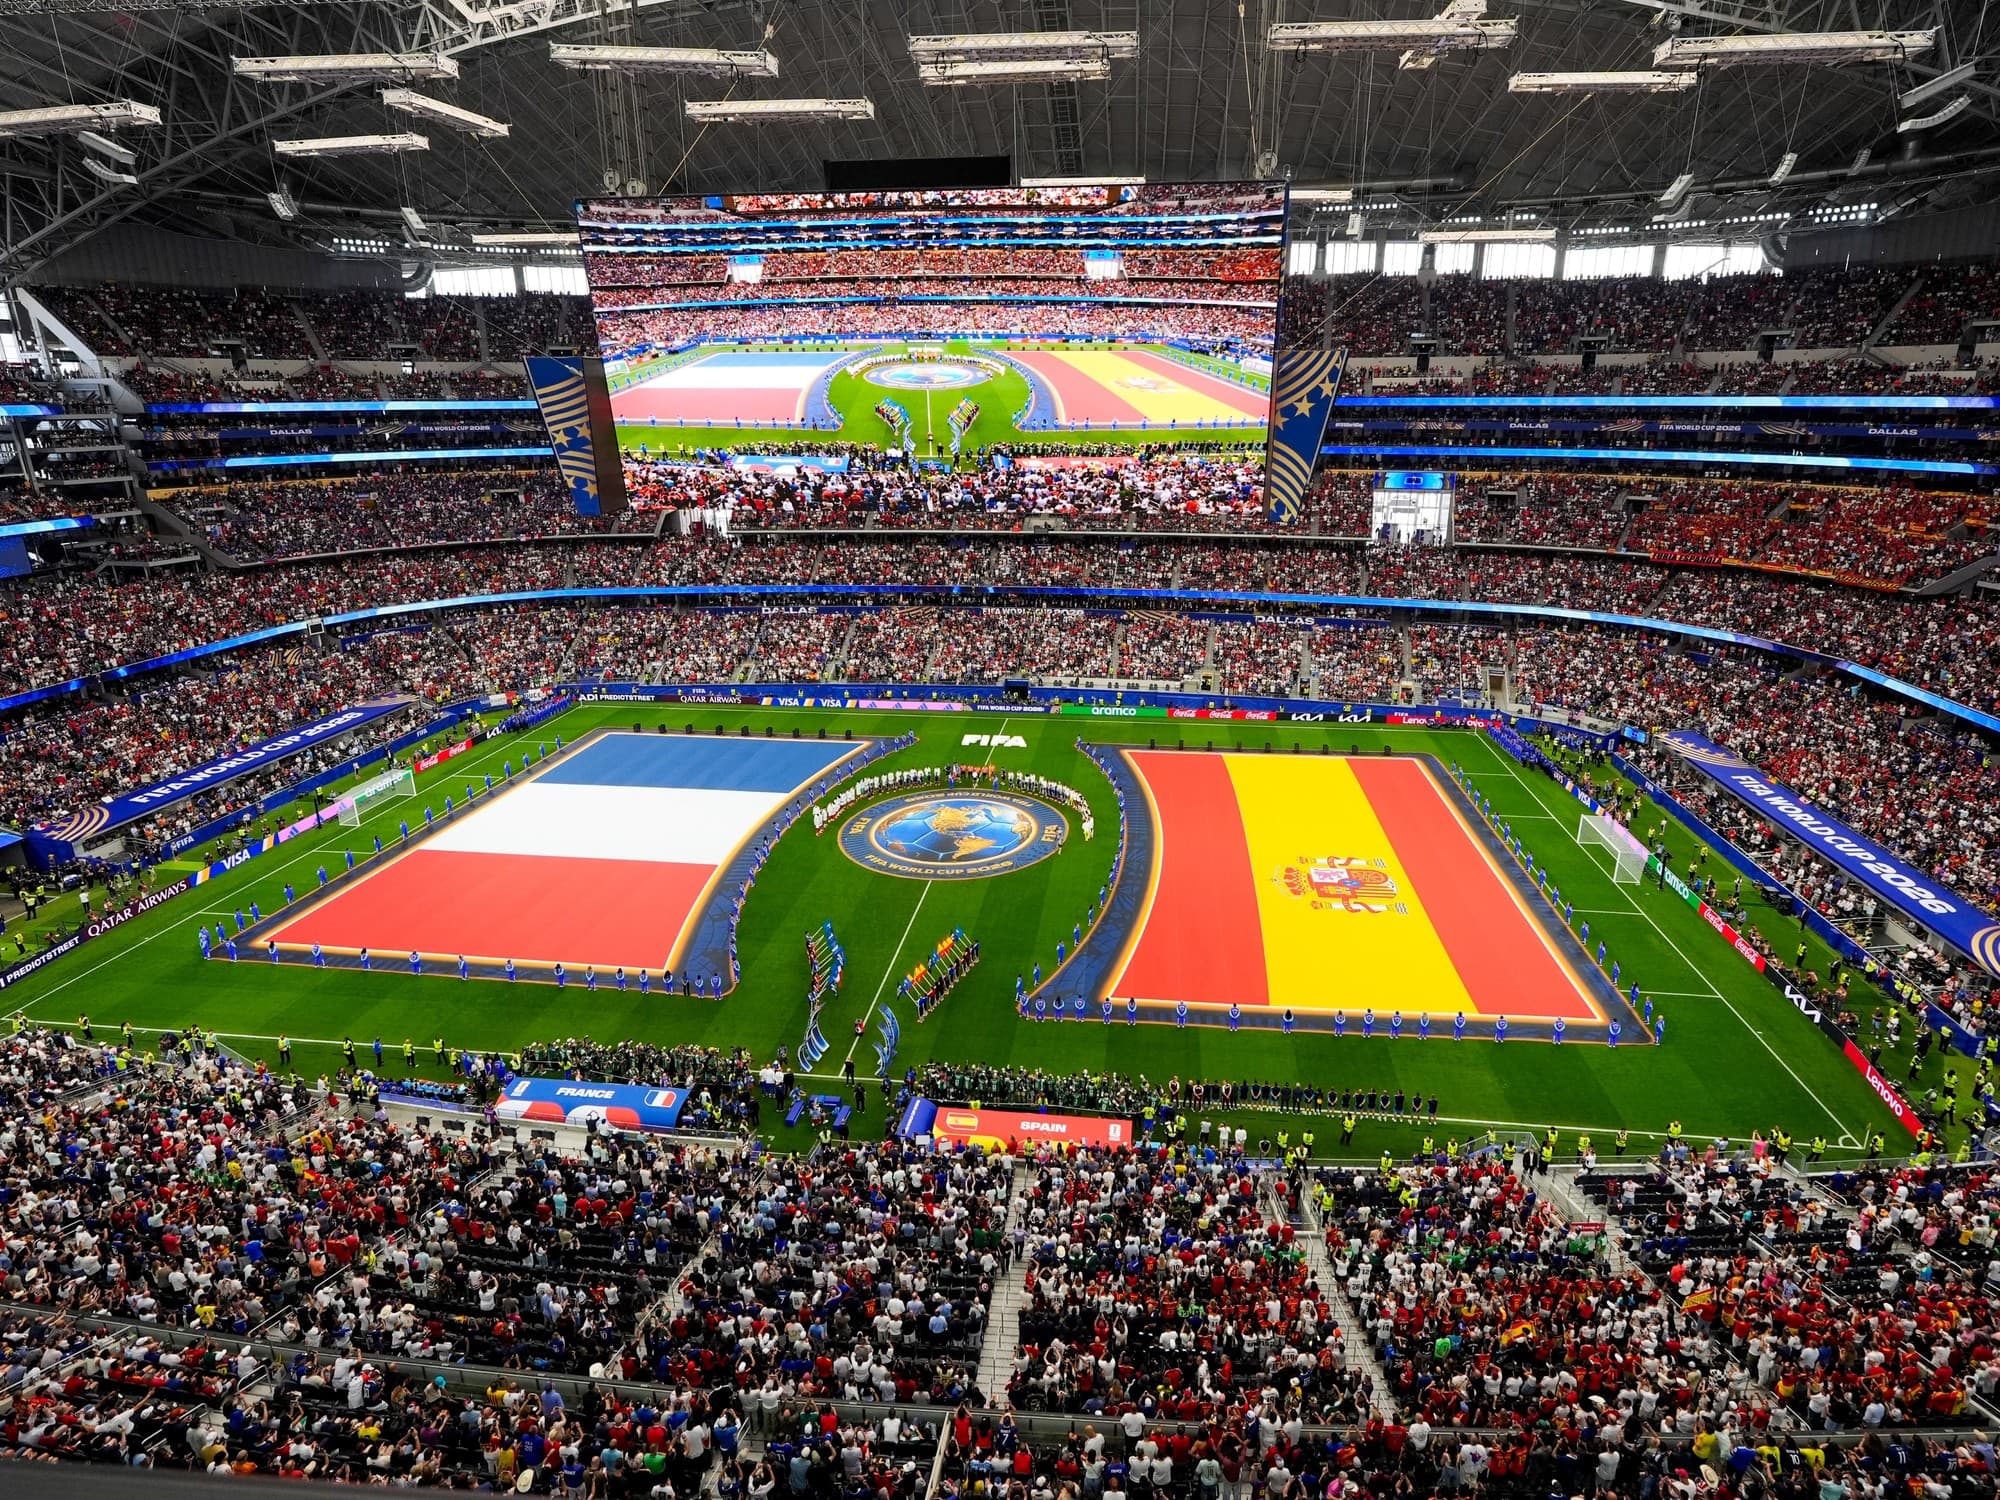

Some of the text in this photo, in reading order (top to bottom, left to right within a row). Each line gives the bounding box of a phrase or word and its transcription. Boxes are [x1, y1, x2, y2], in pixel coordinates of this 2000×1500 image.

[1868, 428, 1918, 436] DALLAS
[762, 607, 818, 615] DALLAS
[1255, 615, 1315, 625] DALLAS
[680, 695, 742, 704] QATAR AIRWAYS
[778, 698, 799, 706] VISA
[820, 699, 842, 707] VISA
[1092, 707, 1137, 716] aramco
[1291, 713, 1323, 722] KIA
[1338, 714, 1371, 723] KIA
[416, 729, 428, 737] FIFA
[961, 734, 1027, 747] FIFA
[129, 711, 364, 803] FIFA WORLD CUP 2026
[365, 774, 403, 797] aramco
[1577, 788, 1591, 808] VISA
[848, 817, 873, 834] FIFA
[176, 835, 195, 849] FIFA
[1731, 775, 1958, 914] FIFA WORLD CUP 2026
[221, 849, 251, 870] VISA
[864, 854, 888, 866] FIFA
[888, 863, 934, 874] WORLD
[967, 860, 1013, 874] 2026
[87, 880, 188, 938] QATAR AIRWAYS
[7, 936, 80, 983] PREDICTSTREET
[1784, 985, 1821, 1023] KIA
[555, 1087, 616, 1099] FRANCE
[1865, 1065, 1903, 1117] Lenovo
[1020, 1121, 1067, 1134] SPAIN
[1002, 1434, 1009, 1445] 7
[1791, 1454, 1800, 1465] 10
[1898, 1452, 1907, 1464] 11
